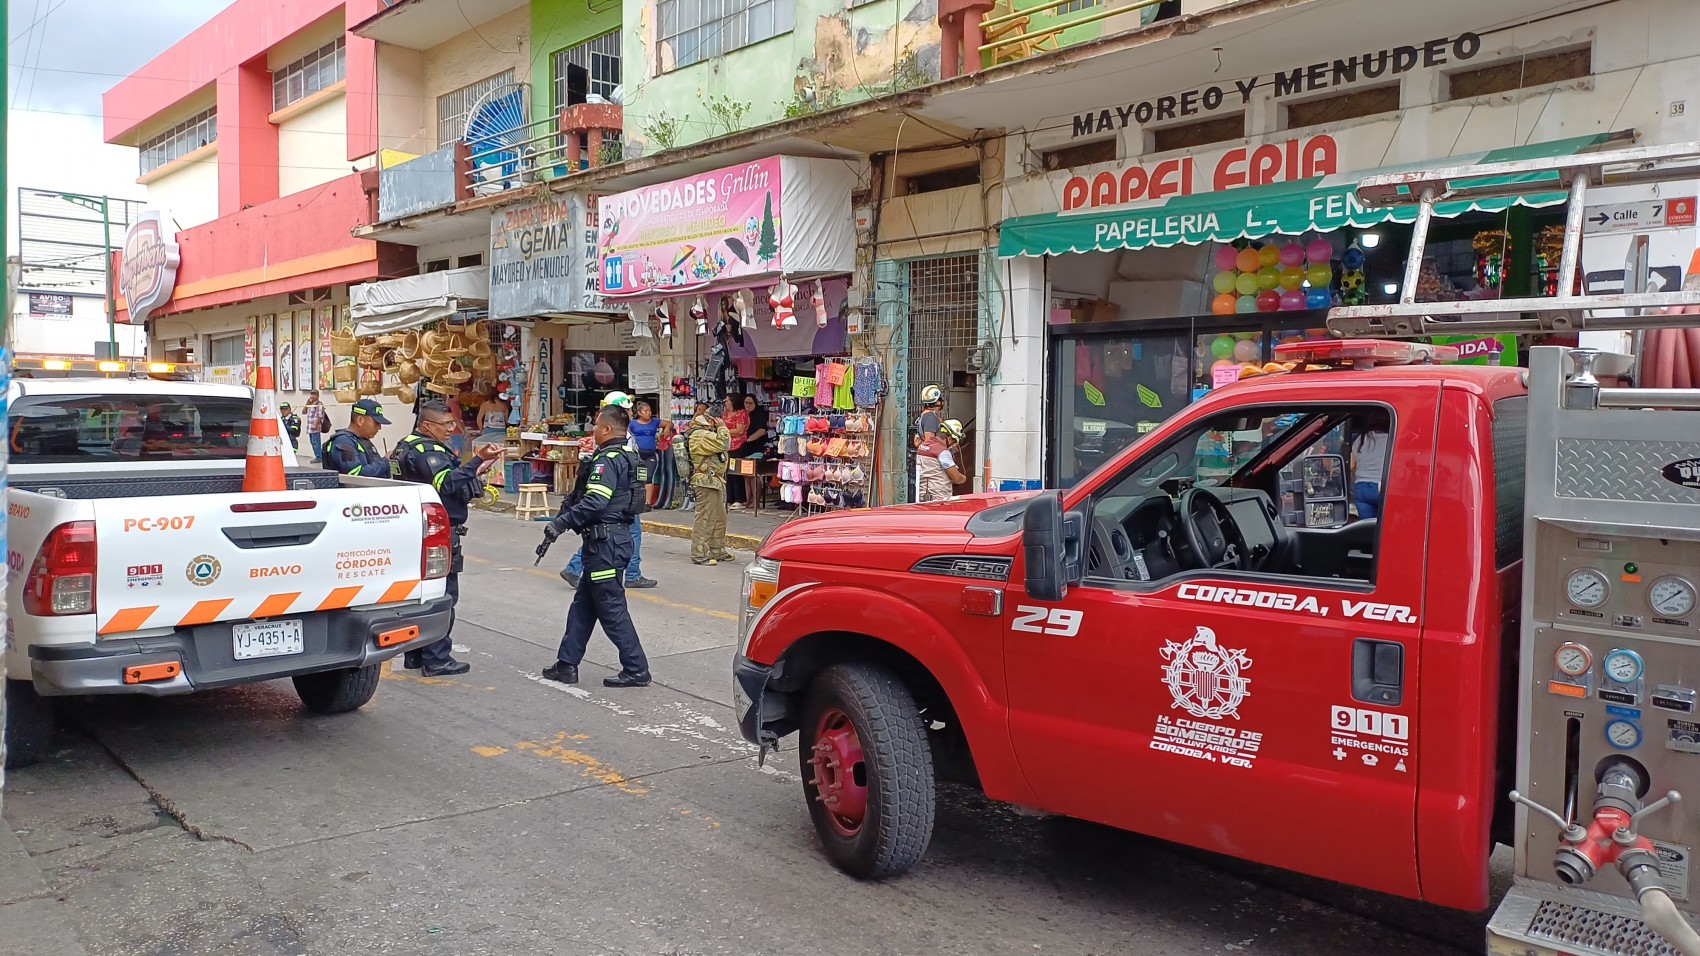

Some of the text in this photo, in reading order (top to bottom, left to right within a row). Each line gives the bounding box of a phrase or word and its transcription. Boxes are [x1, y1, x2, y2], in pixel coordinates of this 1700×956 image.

[1072, 32, 1481, 137] MAYOREO Y MENUDEO
[1671, 103, 1685, 115] 39
[616, 164, 769, 219] NOVEDADES Grillin
[1095, 212, 1220, 243] PAPELERIA
[1309, 192, 1394, 220] FEN
[1613, 210, 1638, 221] Calle
[1652, 205, 1663, 217] 7
[491, 261, 525, 286] MAYOREO
[532, 255, 570, 280] MENUDEO
[1460, 341, 1489, 355] IDA
[8, 503, 30, 519] BRAVO
[124, 515, 195, 533] PC-907
[335, 557, 392, 570] CÓRDOBA
[337, 548, 376, 558] PROTECCIÓN
[128, 565, 162, 576] 911
[249, 564, 302, 578] BRAVO
[337, 568, 386, 579] RESCATE
[1177, 583, 1418, 624] CORDOBA, VER.
[1010, 604, 1084, 638] 29
[237, 628, 300, 649] YJ-4351-A
[1157, 714, 1263, 742] H. CUERPO DE
[1333, 707, 1405, 738] 911
[1155, 723, 1261, 752] BOMBEROS
[1168, 736, 1238, 756] VOLUNTARIOS
[1331, 736, 1409, 757] EMERGENCIAS
[1149, 740, 1253, 769] CORDOBA, VER.
